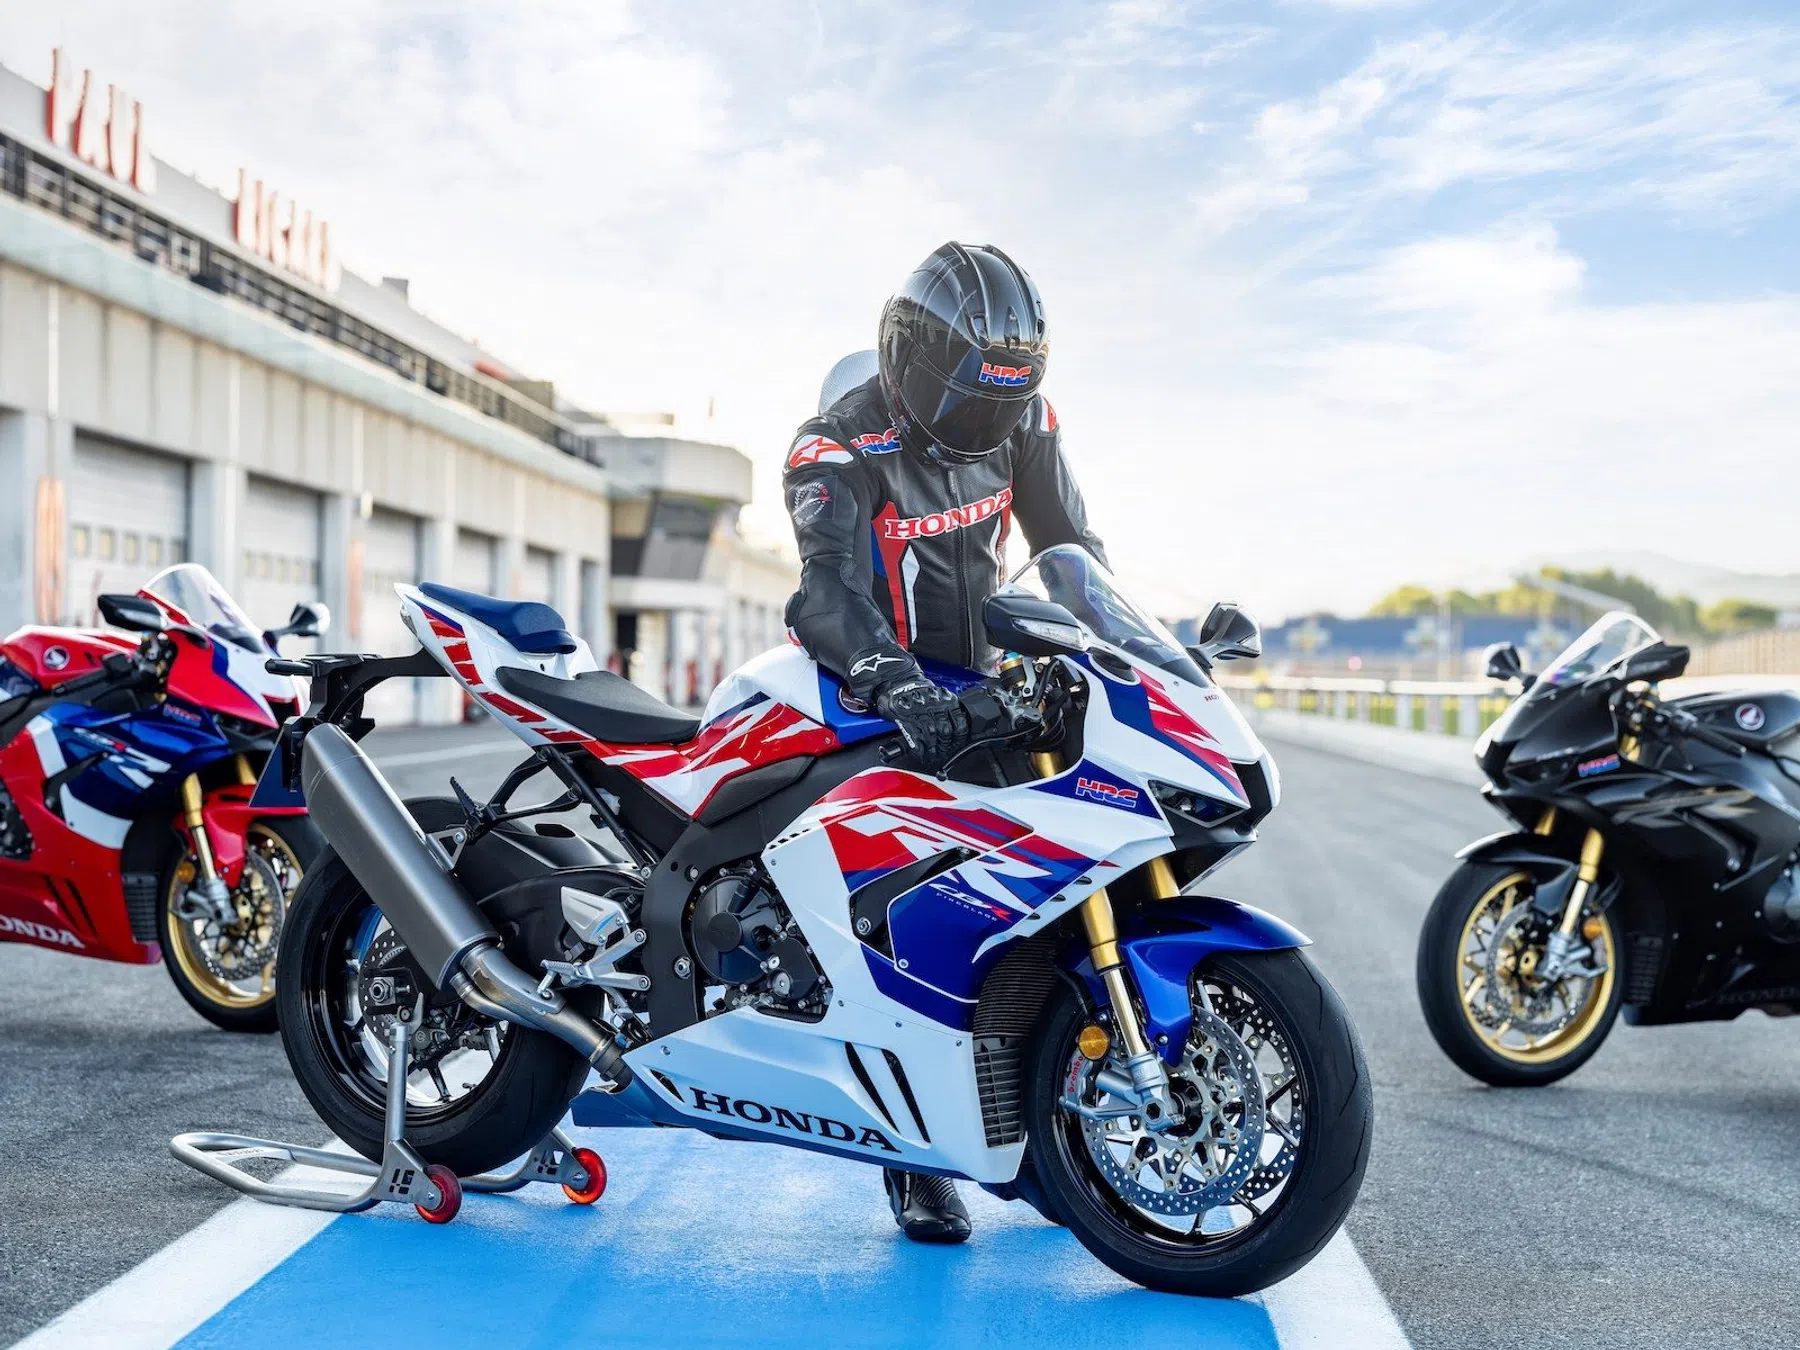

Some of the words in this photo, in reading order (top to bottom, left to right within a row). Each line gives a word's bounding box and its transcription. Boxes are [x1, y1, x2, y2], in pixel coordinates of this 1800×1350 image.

[978, 362, 1032, 387] HRC
[850, 427, 903, 458] HRC
[885, 487, 1013, 539] HONDA
[1075, 777, 1139, 808] HRC
[1067, 1056, 1084, 1093] brembo
[689, 1086, 903, 1154] HONDA
